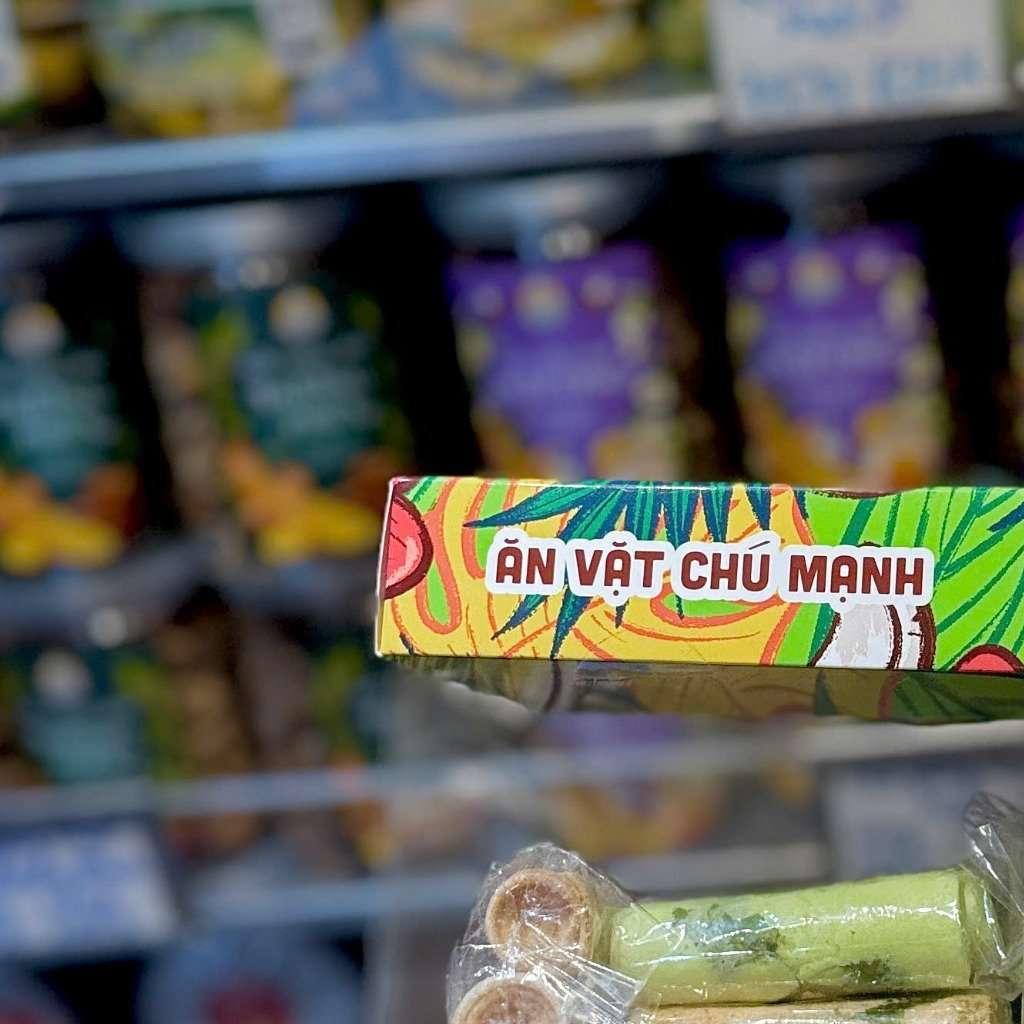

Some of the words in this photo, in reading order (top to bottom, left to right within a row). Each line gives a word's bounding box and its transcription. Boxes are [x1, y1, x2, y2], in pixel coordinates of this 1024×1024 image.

[496, 538, 556, 584] ĂN
[575, 541, 665, 596] VẶT
[681, 540, 771, 592] CHÚ
[788, 554, 924, 603] MẠNH
